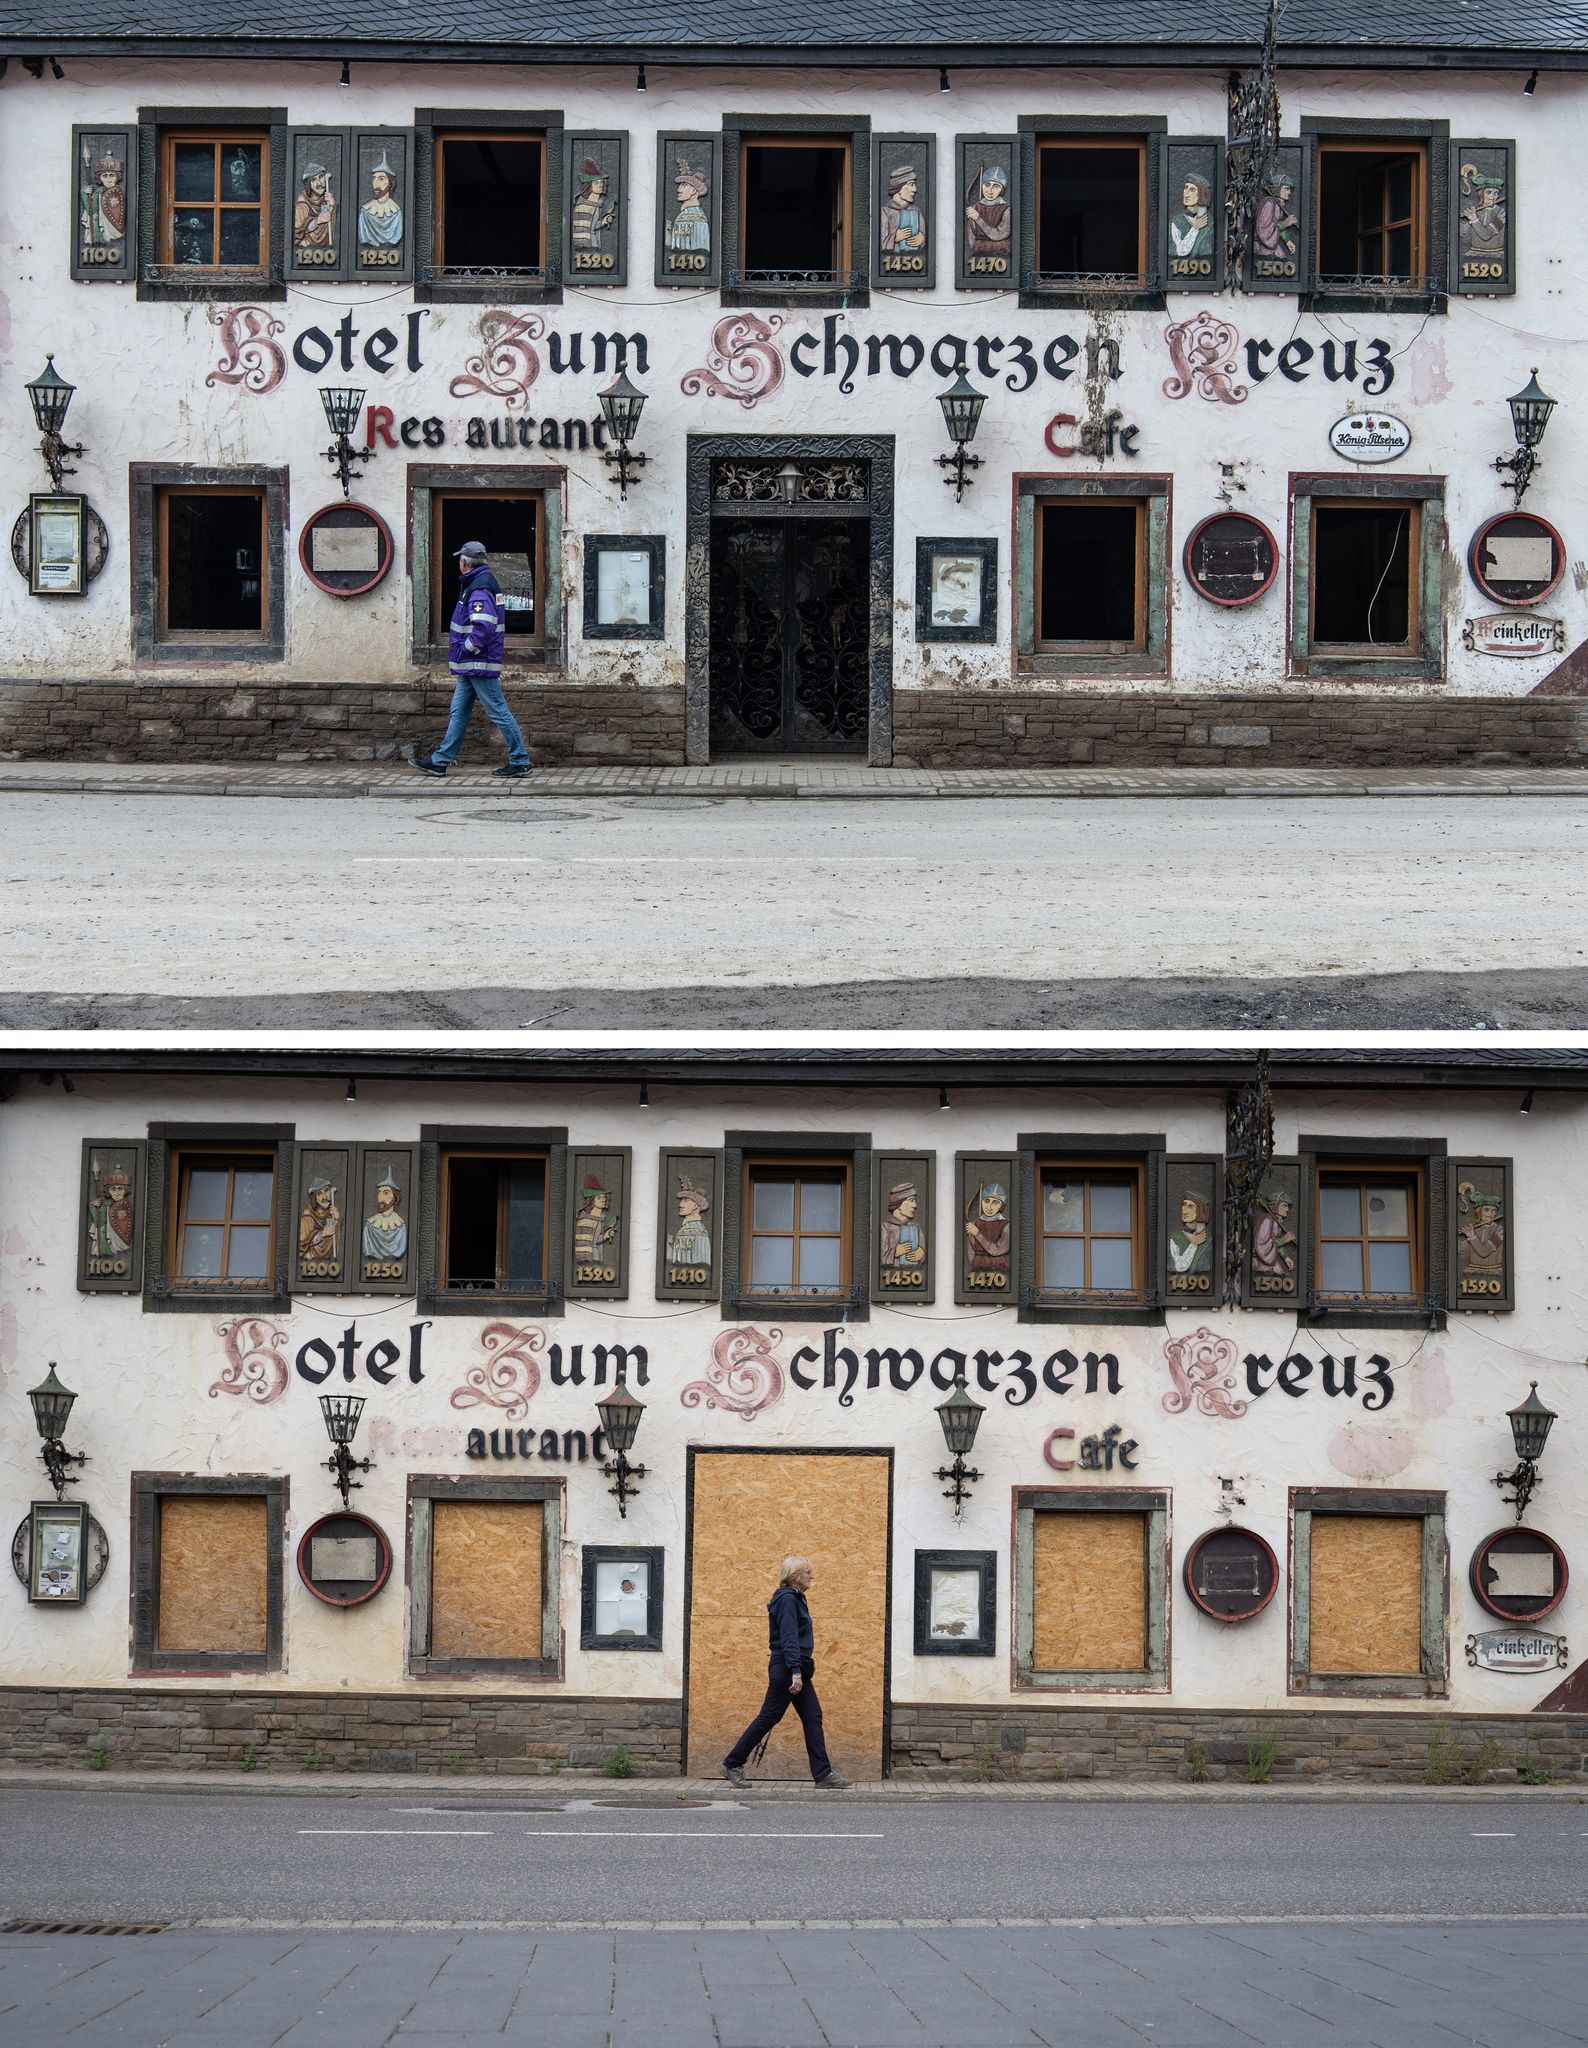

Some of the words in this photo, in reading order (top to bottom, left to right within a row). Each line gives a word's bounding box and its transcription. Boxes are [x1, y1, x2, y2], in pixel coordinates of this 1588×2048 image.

[81, 247, 119, 263] 1100
[296, 249, 336, 265] 1200
[361, 250, 400, 266] 1250
[668, 254, 706, 270] 1410
[883, 256, 923, 271] 1450
[968, 257, 1007, 273] 1470
[1170, 259, 1211, 275] 1490
[1256, 260, 1296, 277] 1500
[1462, 262, 1503, 278] 1520
[449, 310, 651, 411] Zum
[680, 312, 1124, 410] Schwarzen
[1162, 310, 1395, 405] Kreuz
[88, 1260, 127, 1276] 1100
[301, 1261, 340, 1277] 1200
[365, 1263, 403, 1278] 1250
[670, 1268, 707, 1284] 1410
[883, 1270, 923, 1286] 1450
[968, 1272, 1006, 1288] 1470
[1169, 1275, 1210, 1291] 1490
[1254, 1277, 1294, 1292] 1500
[1460, 1279, 1501, 1294] 1520
[450, 1322, 651, 1421] Zum
[680, 1325, 1123, 1421] Schwarzen
[1161, 1326, 1395, 1420] Kreuz
[1043, 1423, 1140, 1472] Cafe
[1482, 1637, 1557, 1657] einkeller
